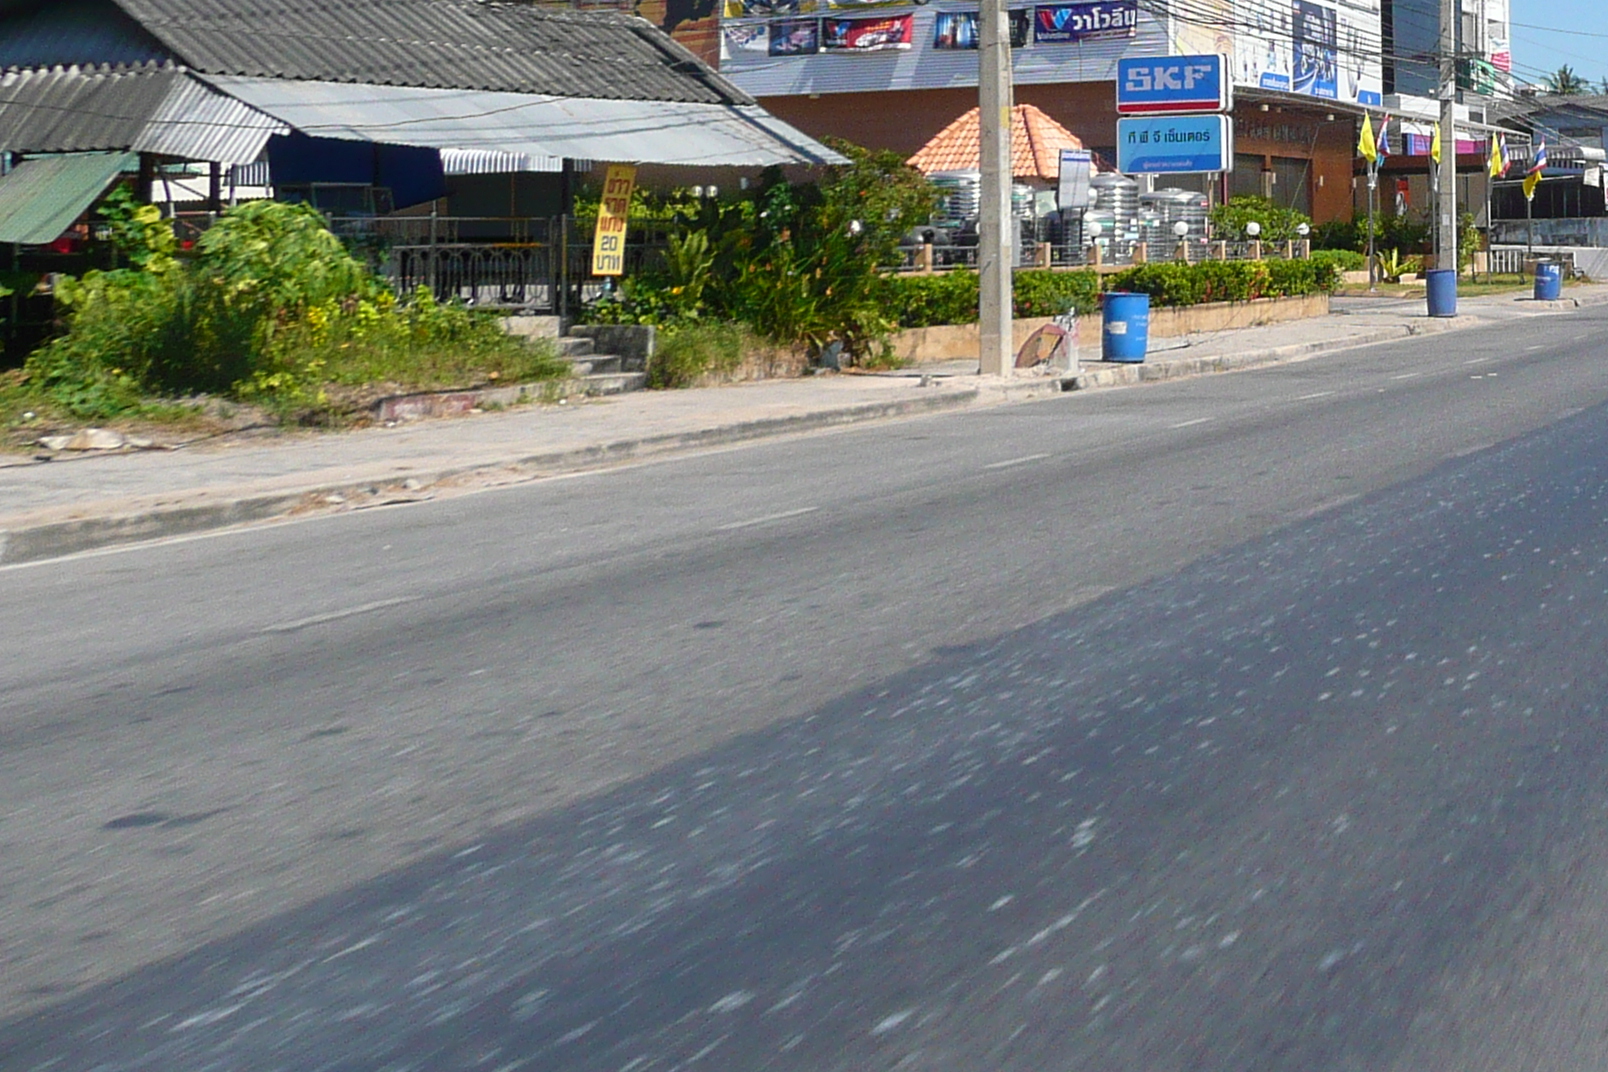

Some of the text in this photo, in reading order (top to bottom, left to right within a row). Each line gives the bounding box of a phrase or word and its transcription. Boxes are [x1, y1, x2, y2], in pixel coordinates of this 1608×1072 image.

[1072, 6, 1136, 31] วาโวลีน
[1125, 65, 1212, 92] SKF
[601, 235, 618, 251] 20
[596, 254, 620, 271] บาท
